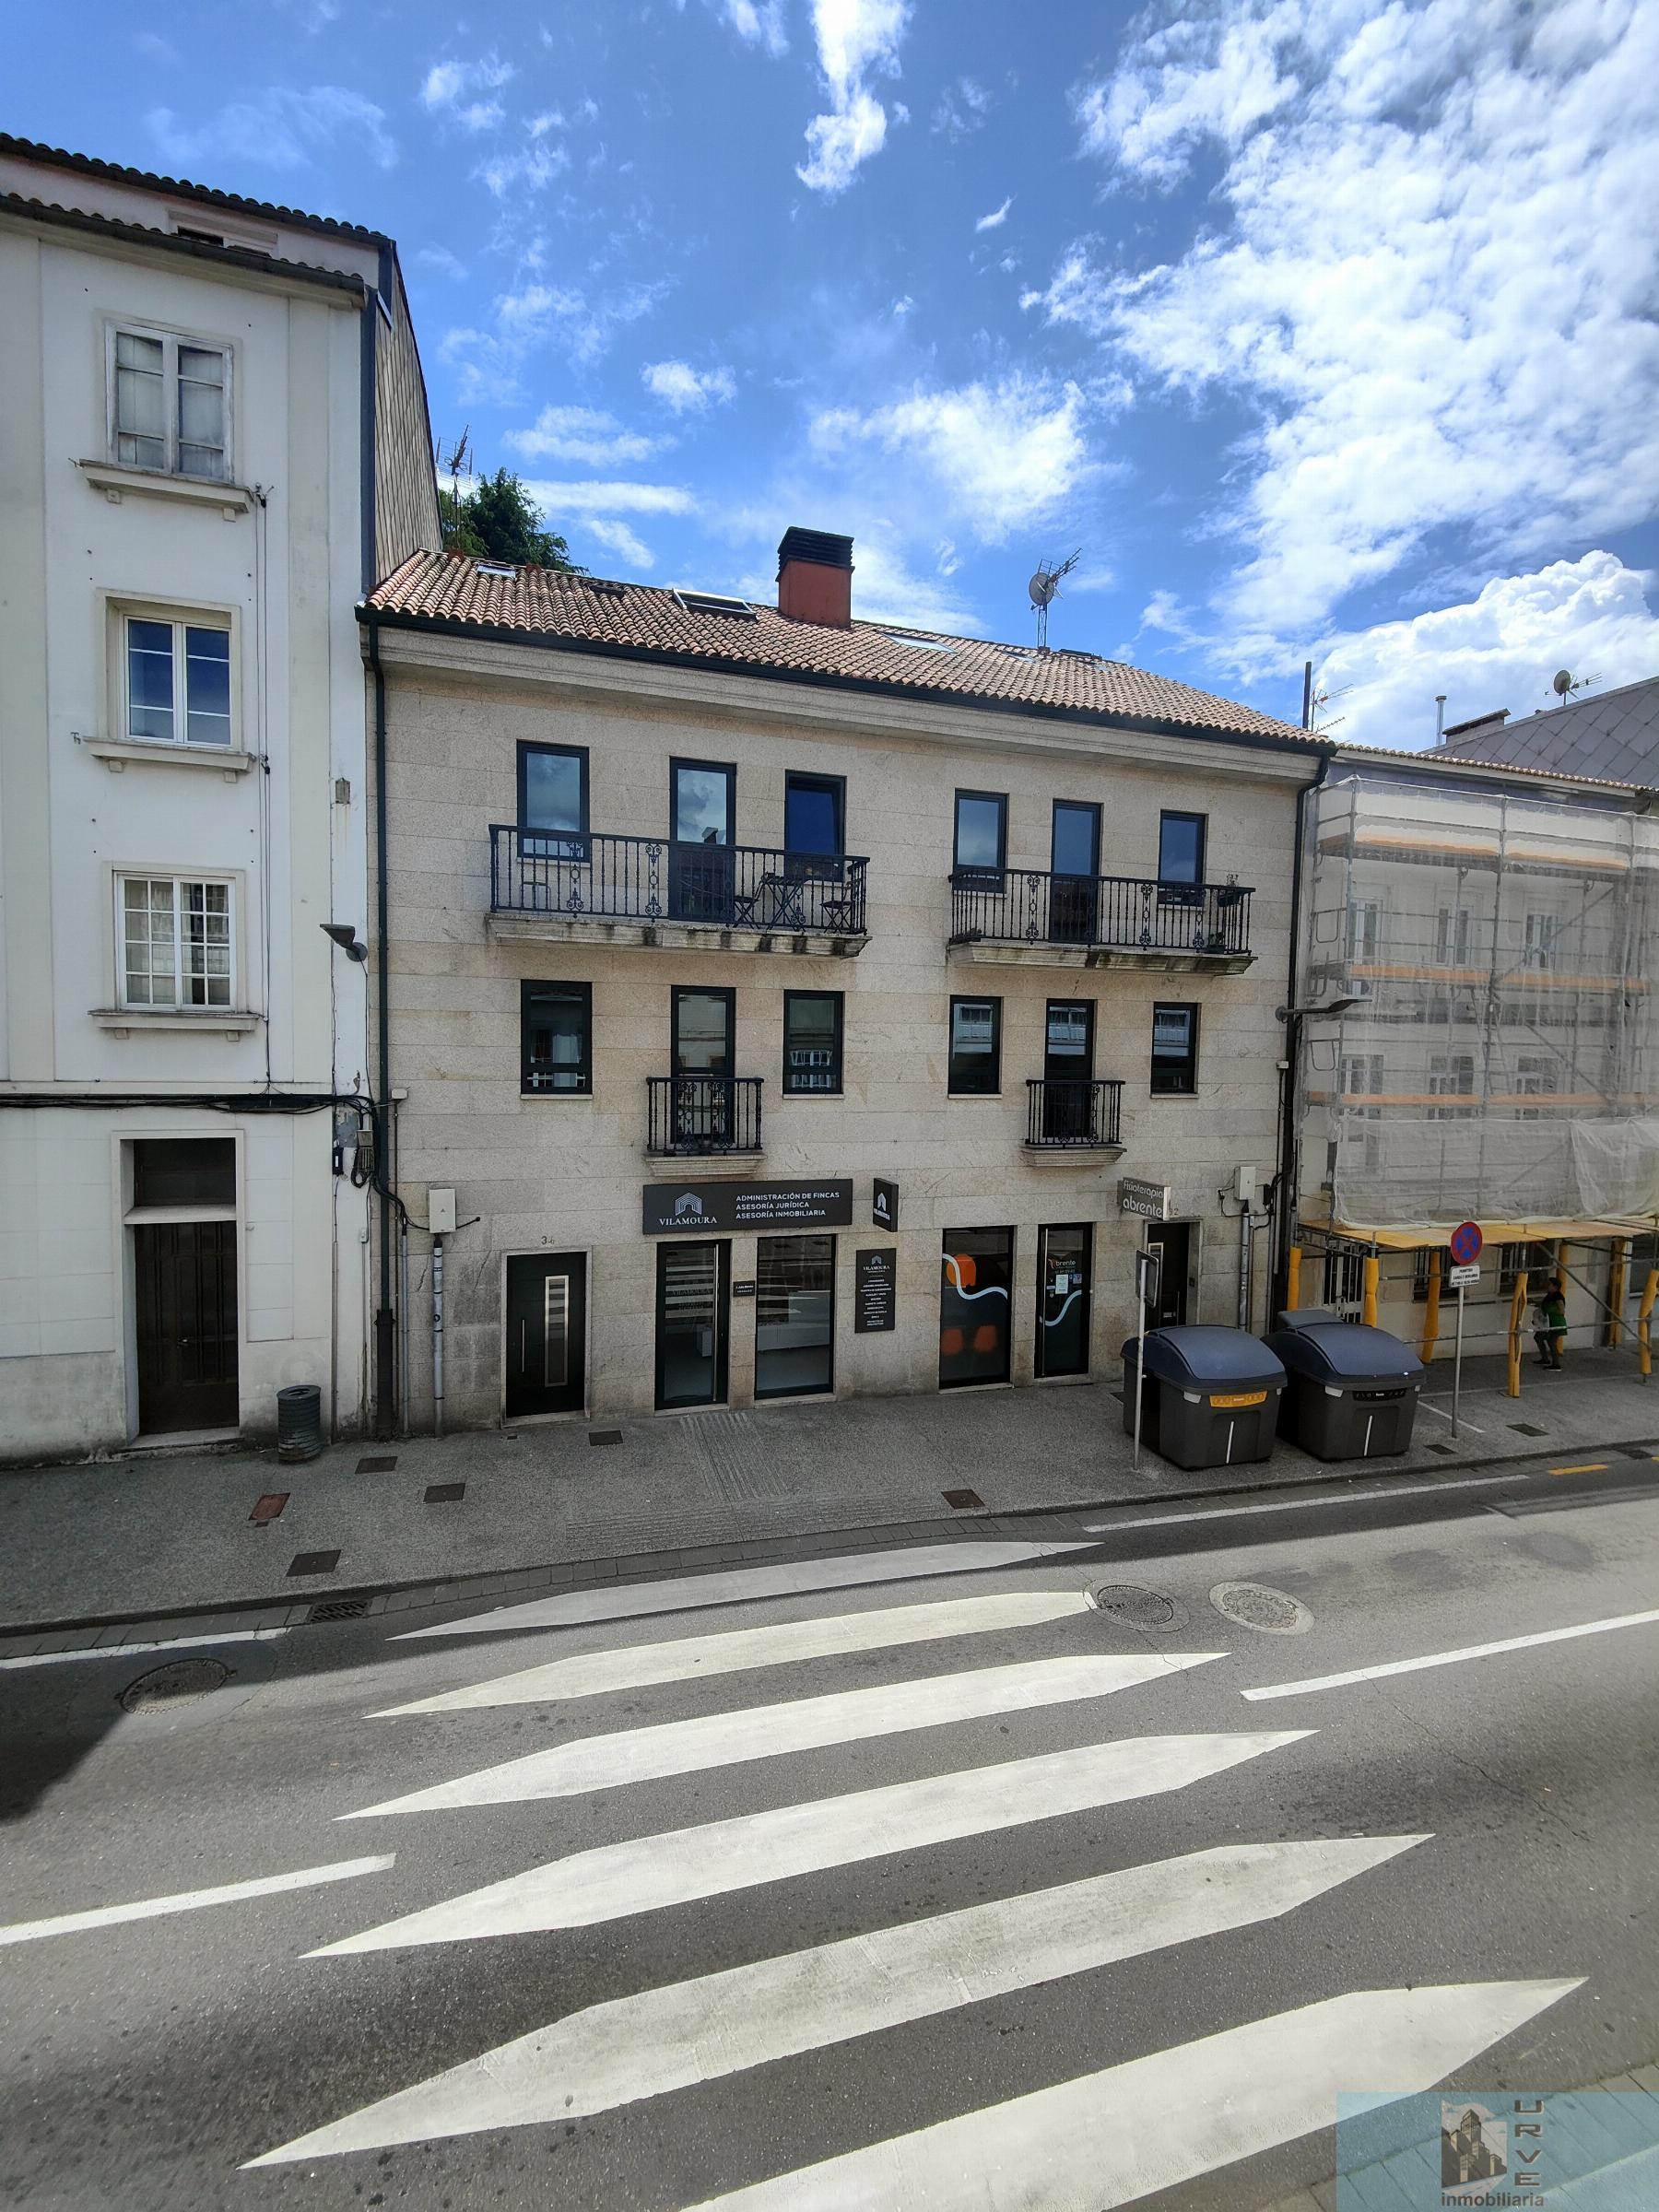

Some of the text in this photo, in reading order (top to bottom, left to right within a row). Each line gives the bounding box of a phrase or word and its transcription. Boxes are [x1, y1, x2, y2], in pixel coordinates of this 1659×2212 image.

[736, 1193, 800, 1202] ADMINISTRACIÓN
[775, 1201, 809, 1209] JURÍDICA
[1123, 1195, 1162, 1218] abrente
[735, 1209, 826, 1219] ASESORÍA INMOBILIARIA
[659, 1216, 717, 1227] VILAMOURA
